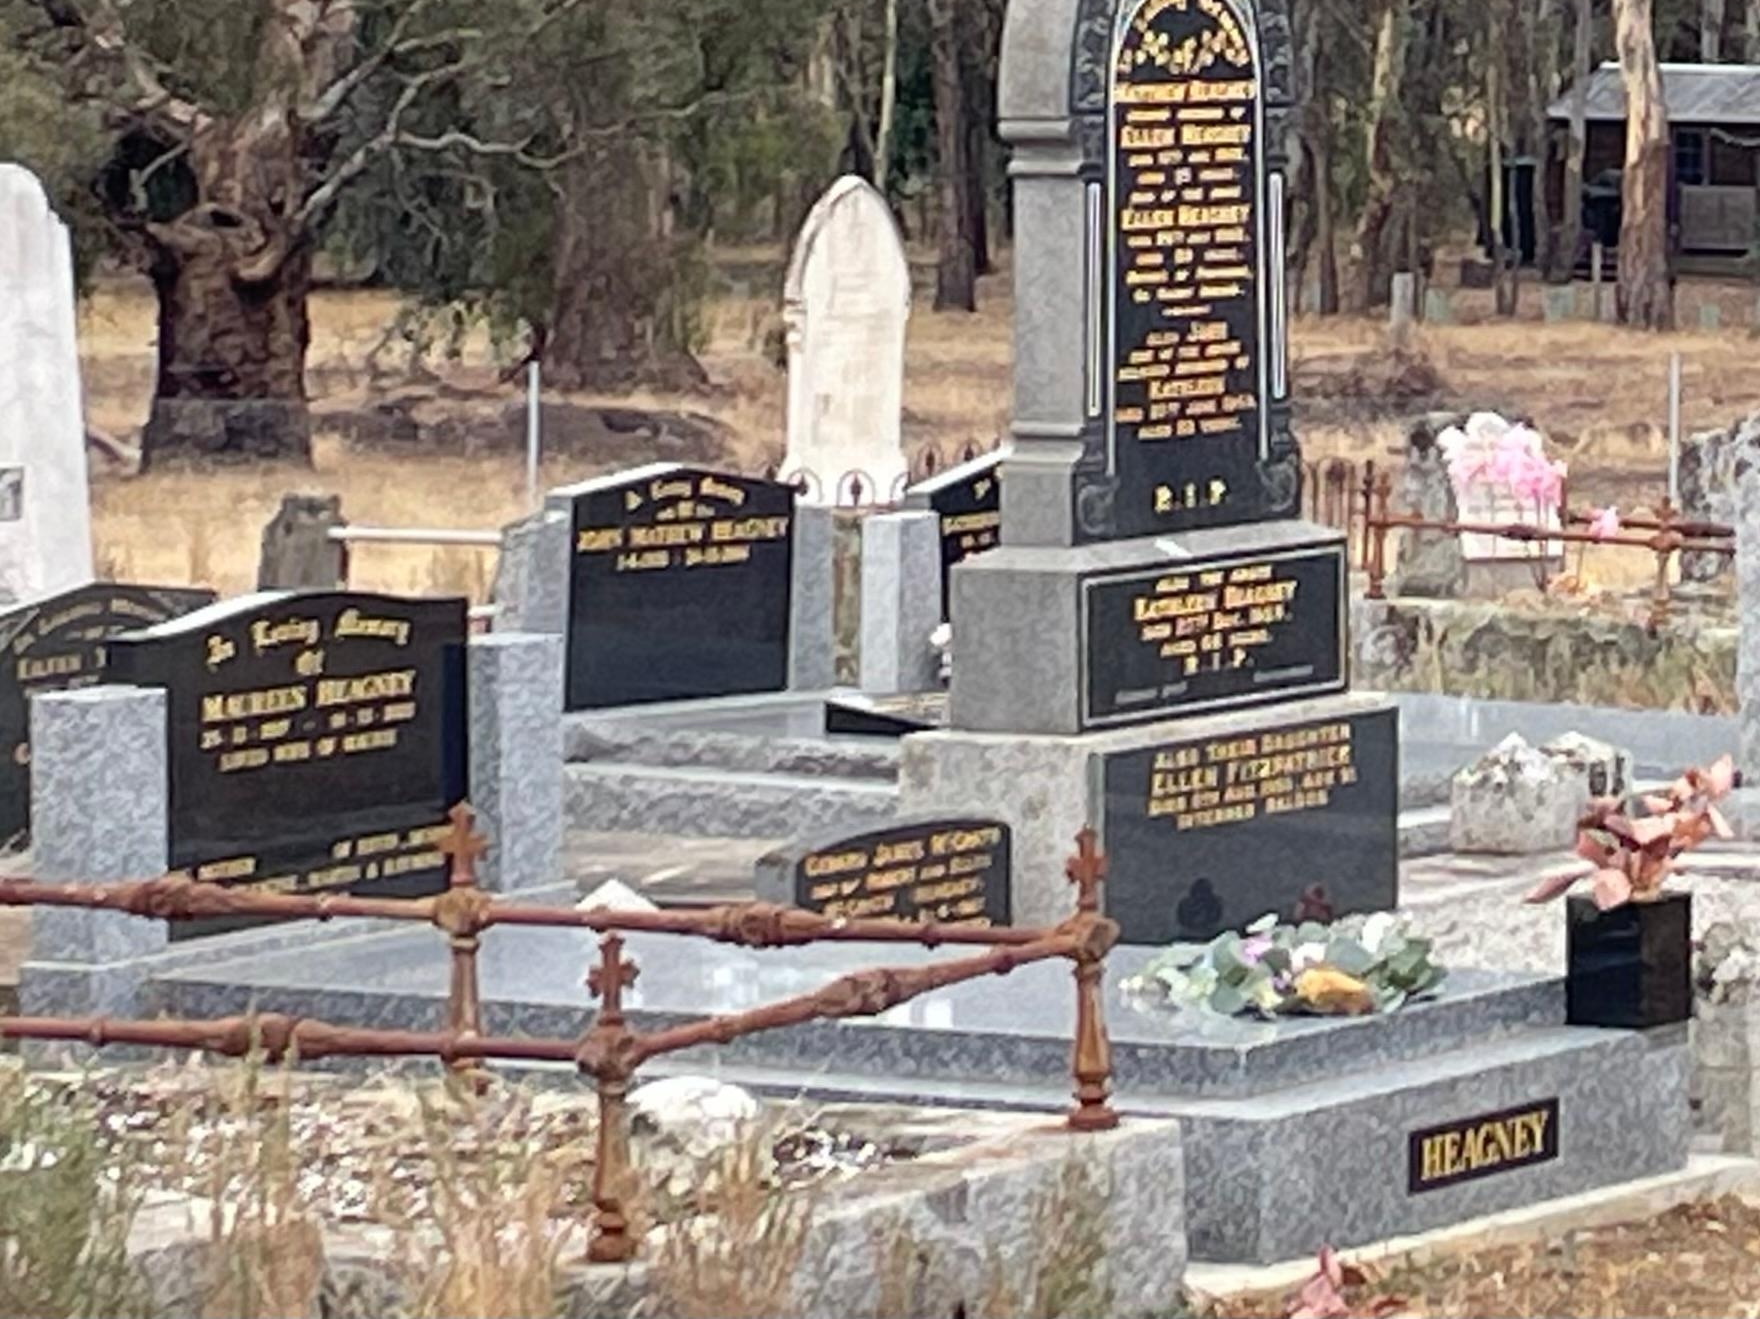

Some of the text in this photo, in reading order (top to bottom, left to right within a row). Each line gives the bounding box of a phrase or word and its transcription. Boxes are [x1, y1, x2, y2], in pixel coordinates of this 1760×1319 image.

[250, 615, 321, 656] Loving
[333, 607, 412, 646] Memory
[314, 669, 417, 708] HEAGNEY
[1150, 745, 1351, 797] ELLEN FITZPATRICK
[1153, 723, 1351, 771] ALSO THEIR DAUGHTER
[1420, 1109, 1550, 1182] HEAGNEY
